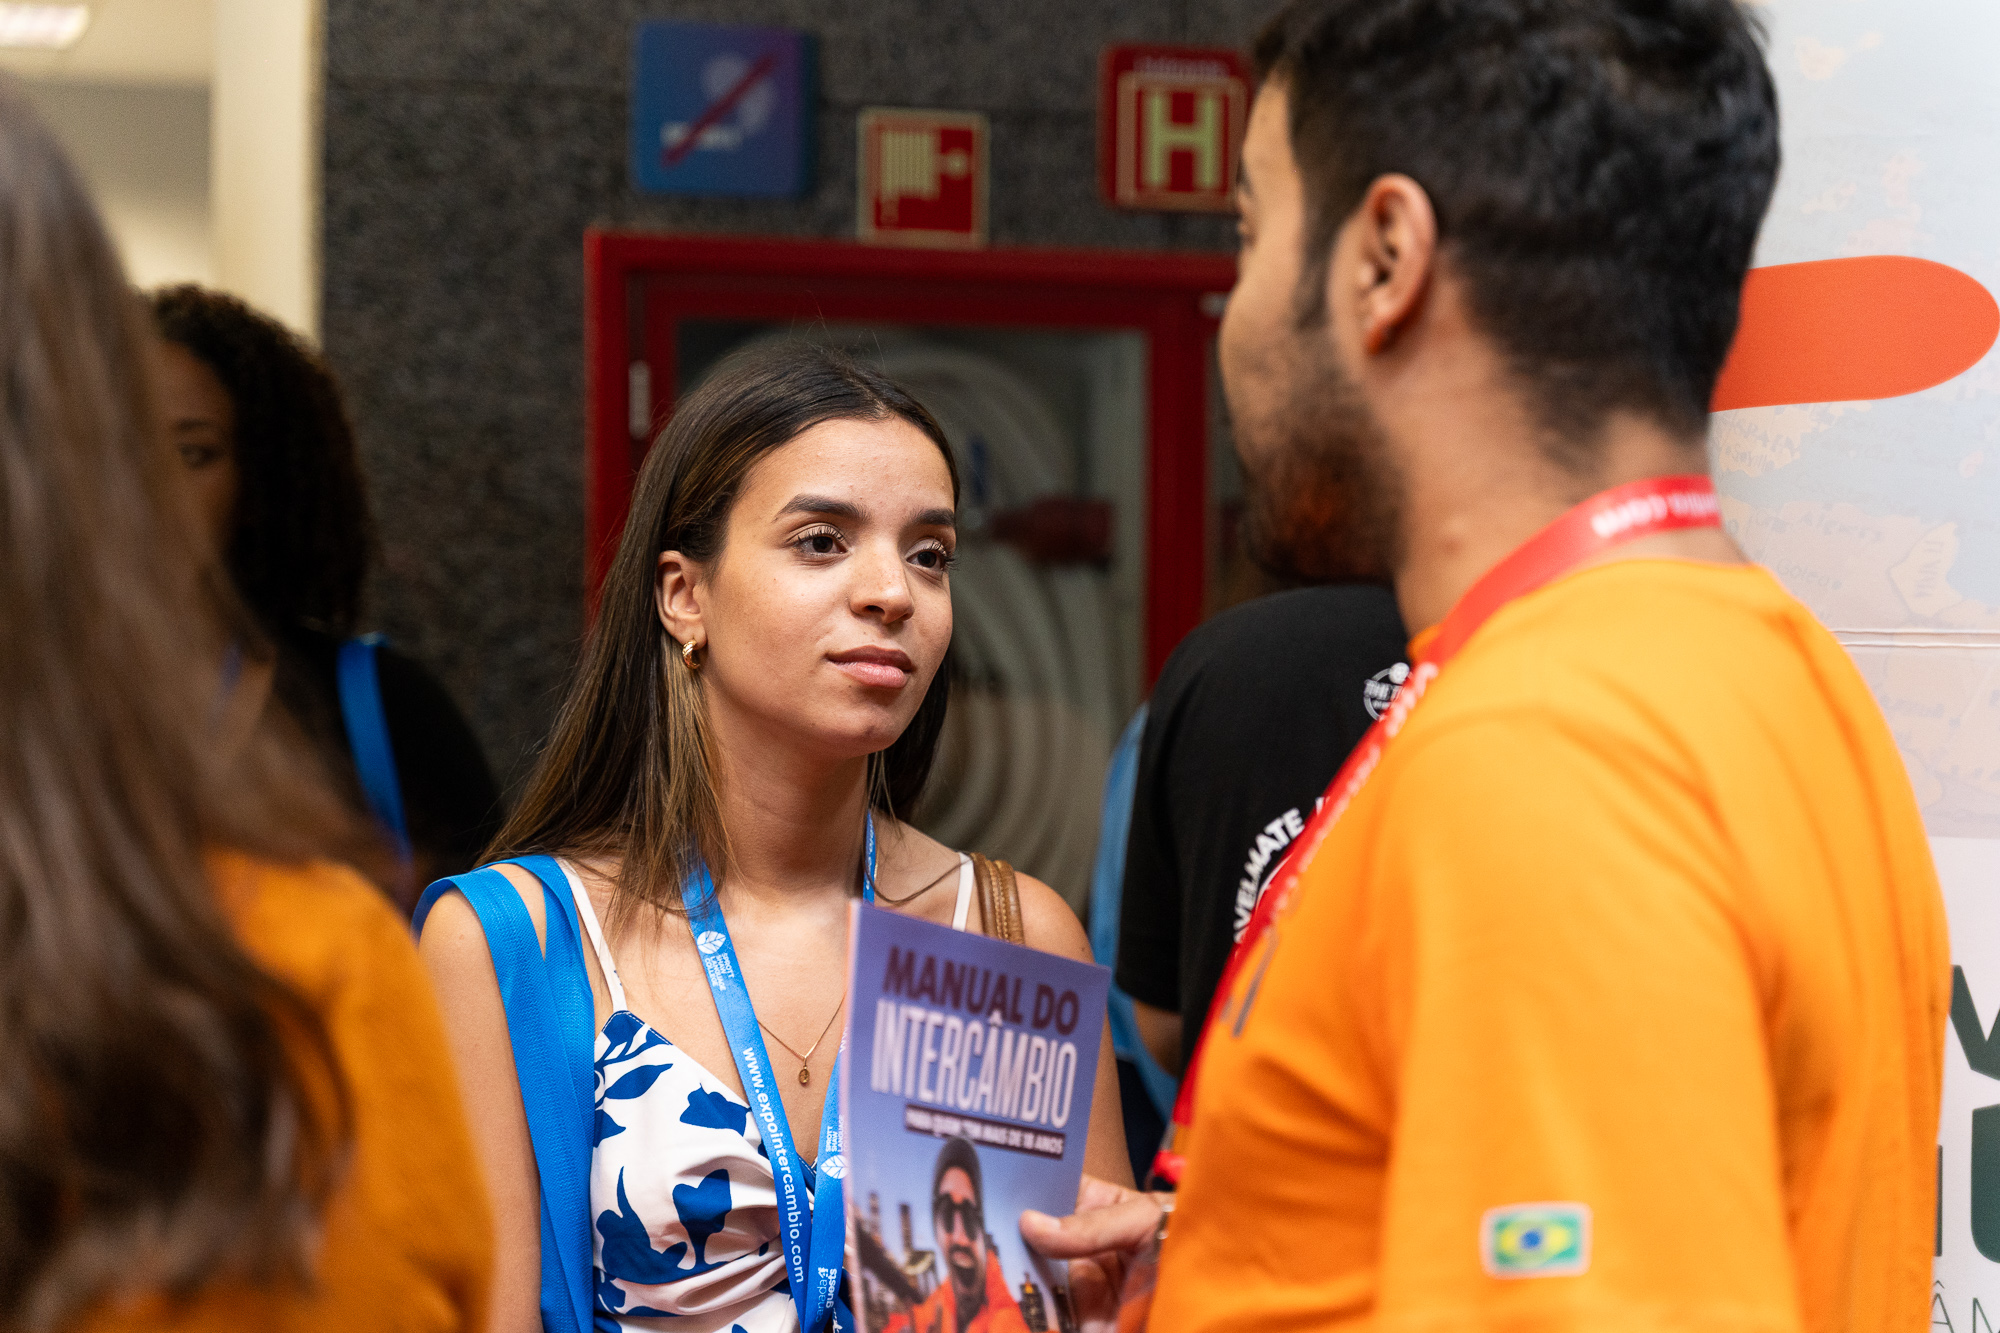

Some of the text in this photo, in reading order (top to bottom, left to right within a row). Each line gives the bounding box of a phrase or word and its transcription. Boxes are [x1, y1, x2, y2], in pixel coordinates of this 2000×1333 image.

[1144, 92, 1220, 188] H
[705, 957, 718, 987] COLLEGE
[710, 955, 727, 991] LANGUAGE
[722, 952, 735, 978] SPROTT
[882, 945, 1080, 1036] MANUAL DO
[870, 998, 1078, 1129] INTERCÂMBIO
[825, 1125, 834, 1152] SPROTT
[742, 1047, 805, 1283] www.expointercambio.com
[825, 1268, 838, 1309] guests
